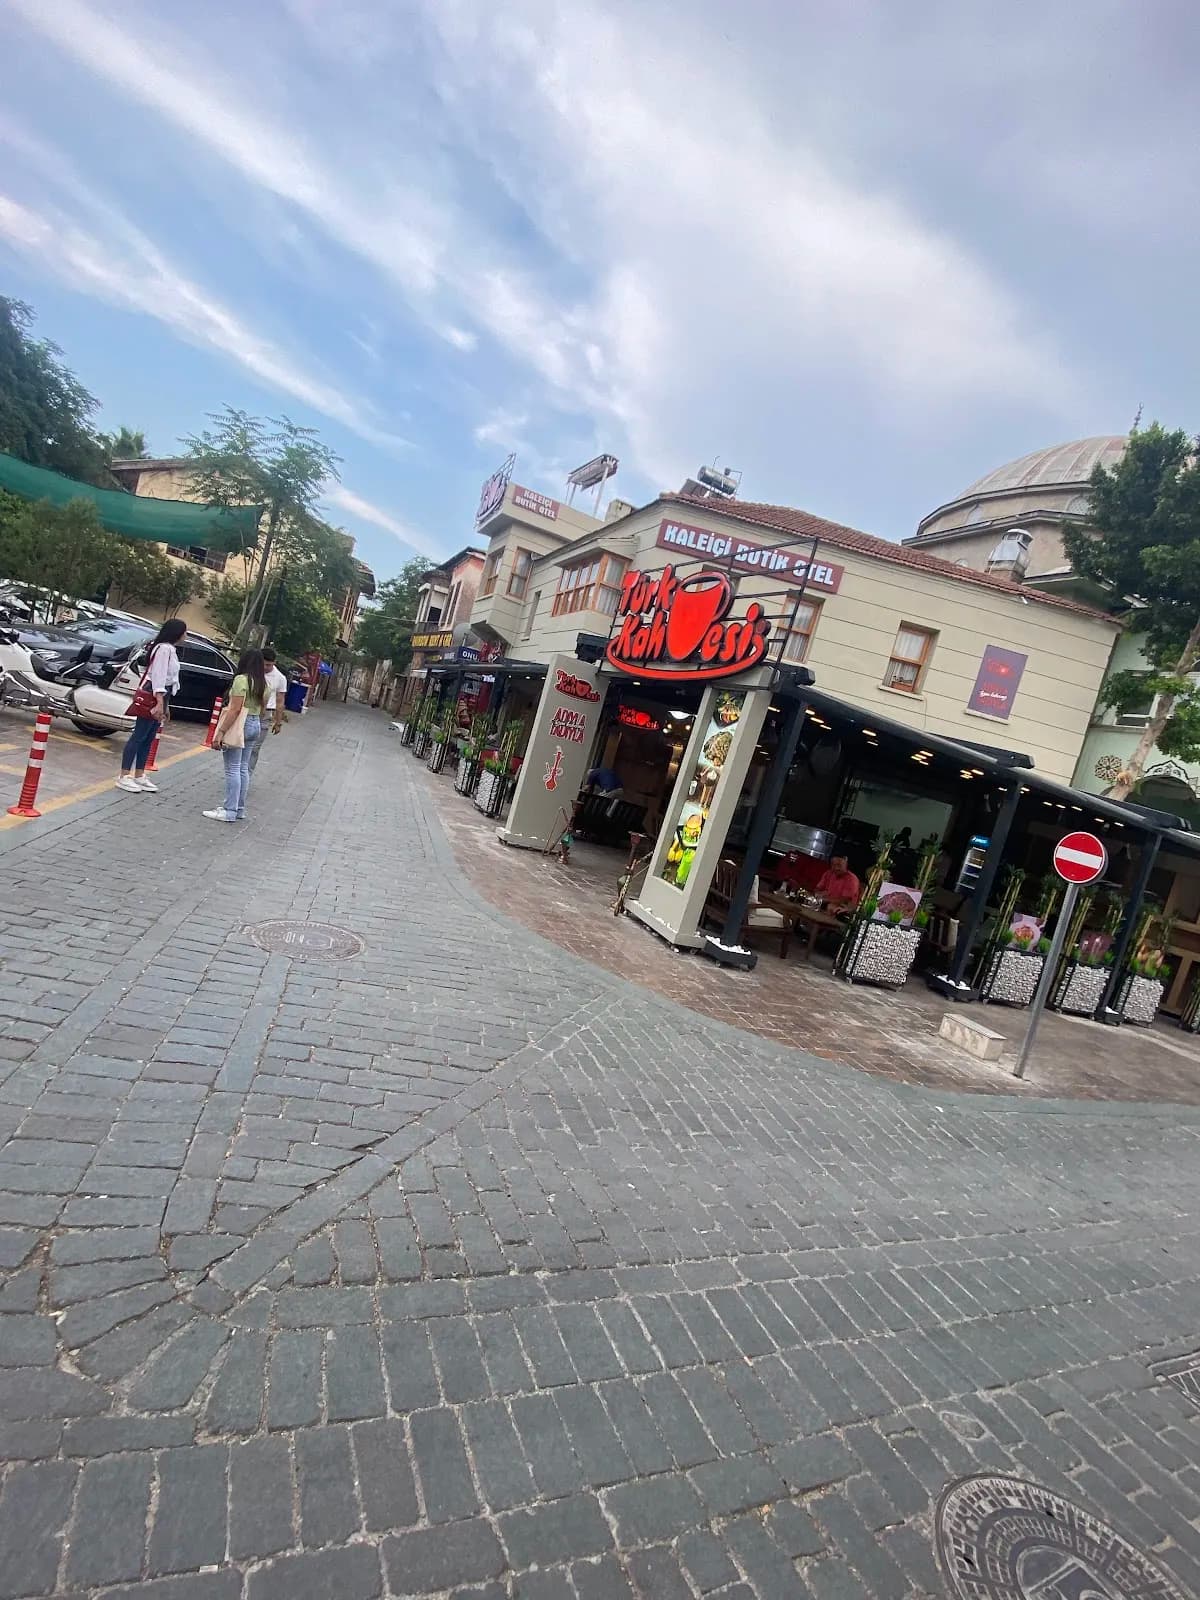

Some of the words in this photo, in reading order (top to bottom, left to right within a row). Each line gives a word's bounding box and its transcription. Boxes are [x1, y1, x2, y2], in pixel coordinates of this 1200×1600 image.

[539, 506, 555, 518] OTEL
[664, 525, 733, 557] KALEİÇİ
[735, 543, 789, 571] BUTİK
[793, 560, 834, 586] OTEL
